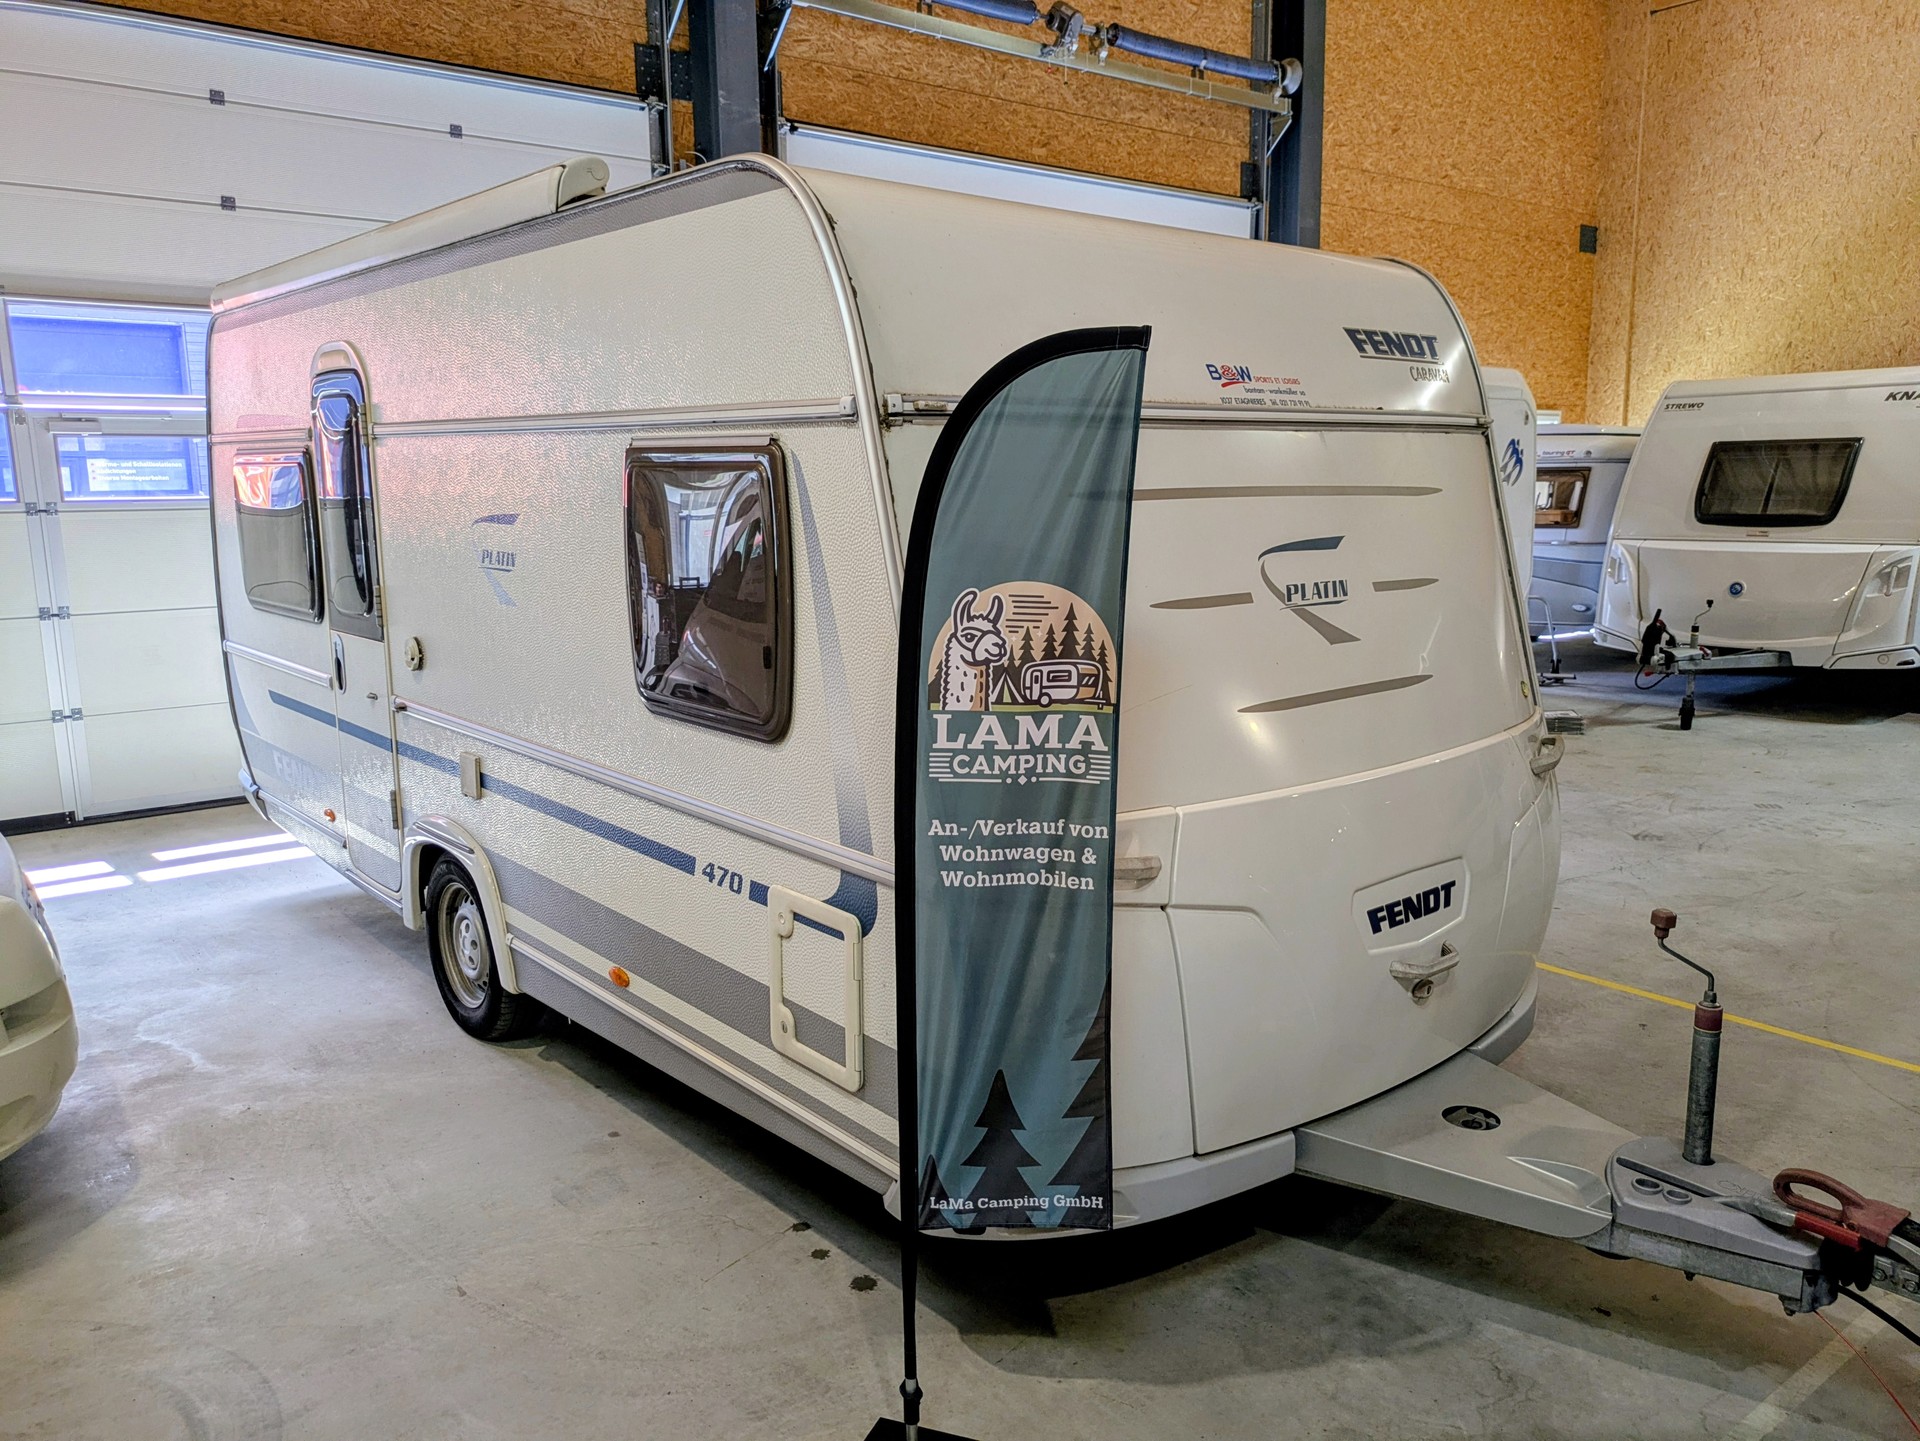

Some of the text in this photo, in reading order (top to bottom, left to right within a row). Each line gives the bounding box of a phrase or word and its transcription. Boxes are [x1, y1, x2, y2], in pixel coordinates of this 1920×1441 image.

[1342, 327, 1439, 360] FENDT
[1205, 363, 1253, 382] B&W
[1253, 376, 1274, 384] SPORTS
[1409, 366, 1450, 383] CARAVAN
[1664, 402, 1704, 410] STREWO
[482, 549, 517, 567] PLATIN
[1286, 579, 1348, 602] PLATIN
[932, 714, 1109, 751] LAMA
[953, 754, 1086, 774] CAMPING
[928, 819, 1109, 840] An-/Verkauf von
[939, 845, 1097, 864] Wohnwagen &
[702, 862, 743, 894] 470
[941, 869, 1095, 890] Wohnmobilen
[1367, 880, 1456, 935] FENDT
[929, 1194, 1104, 1210] LaMa Camping GmbH
